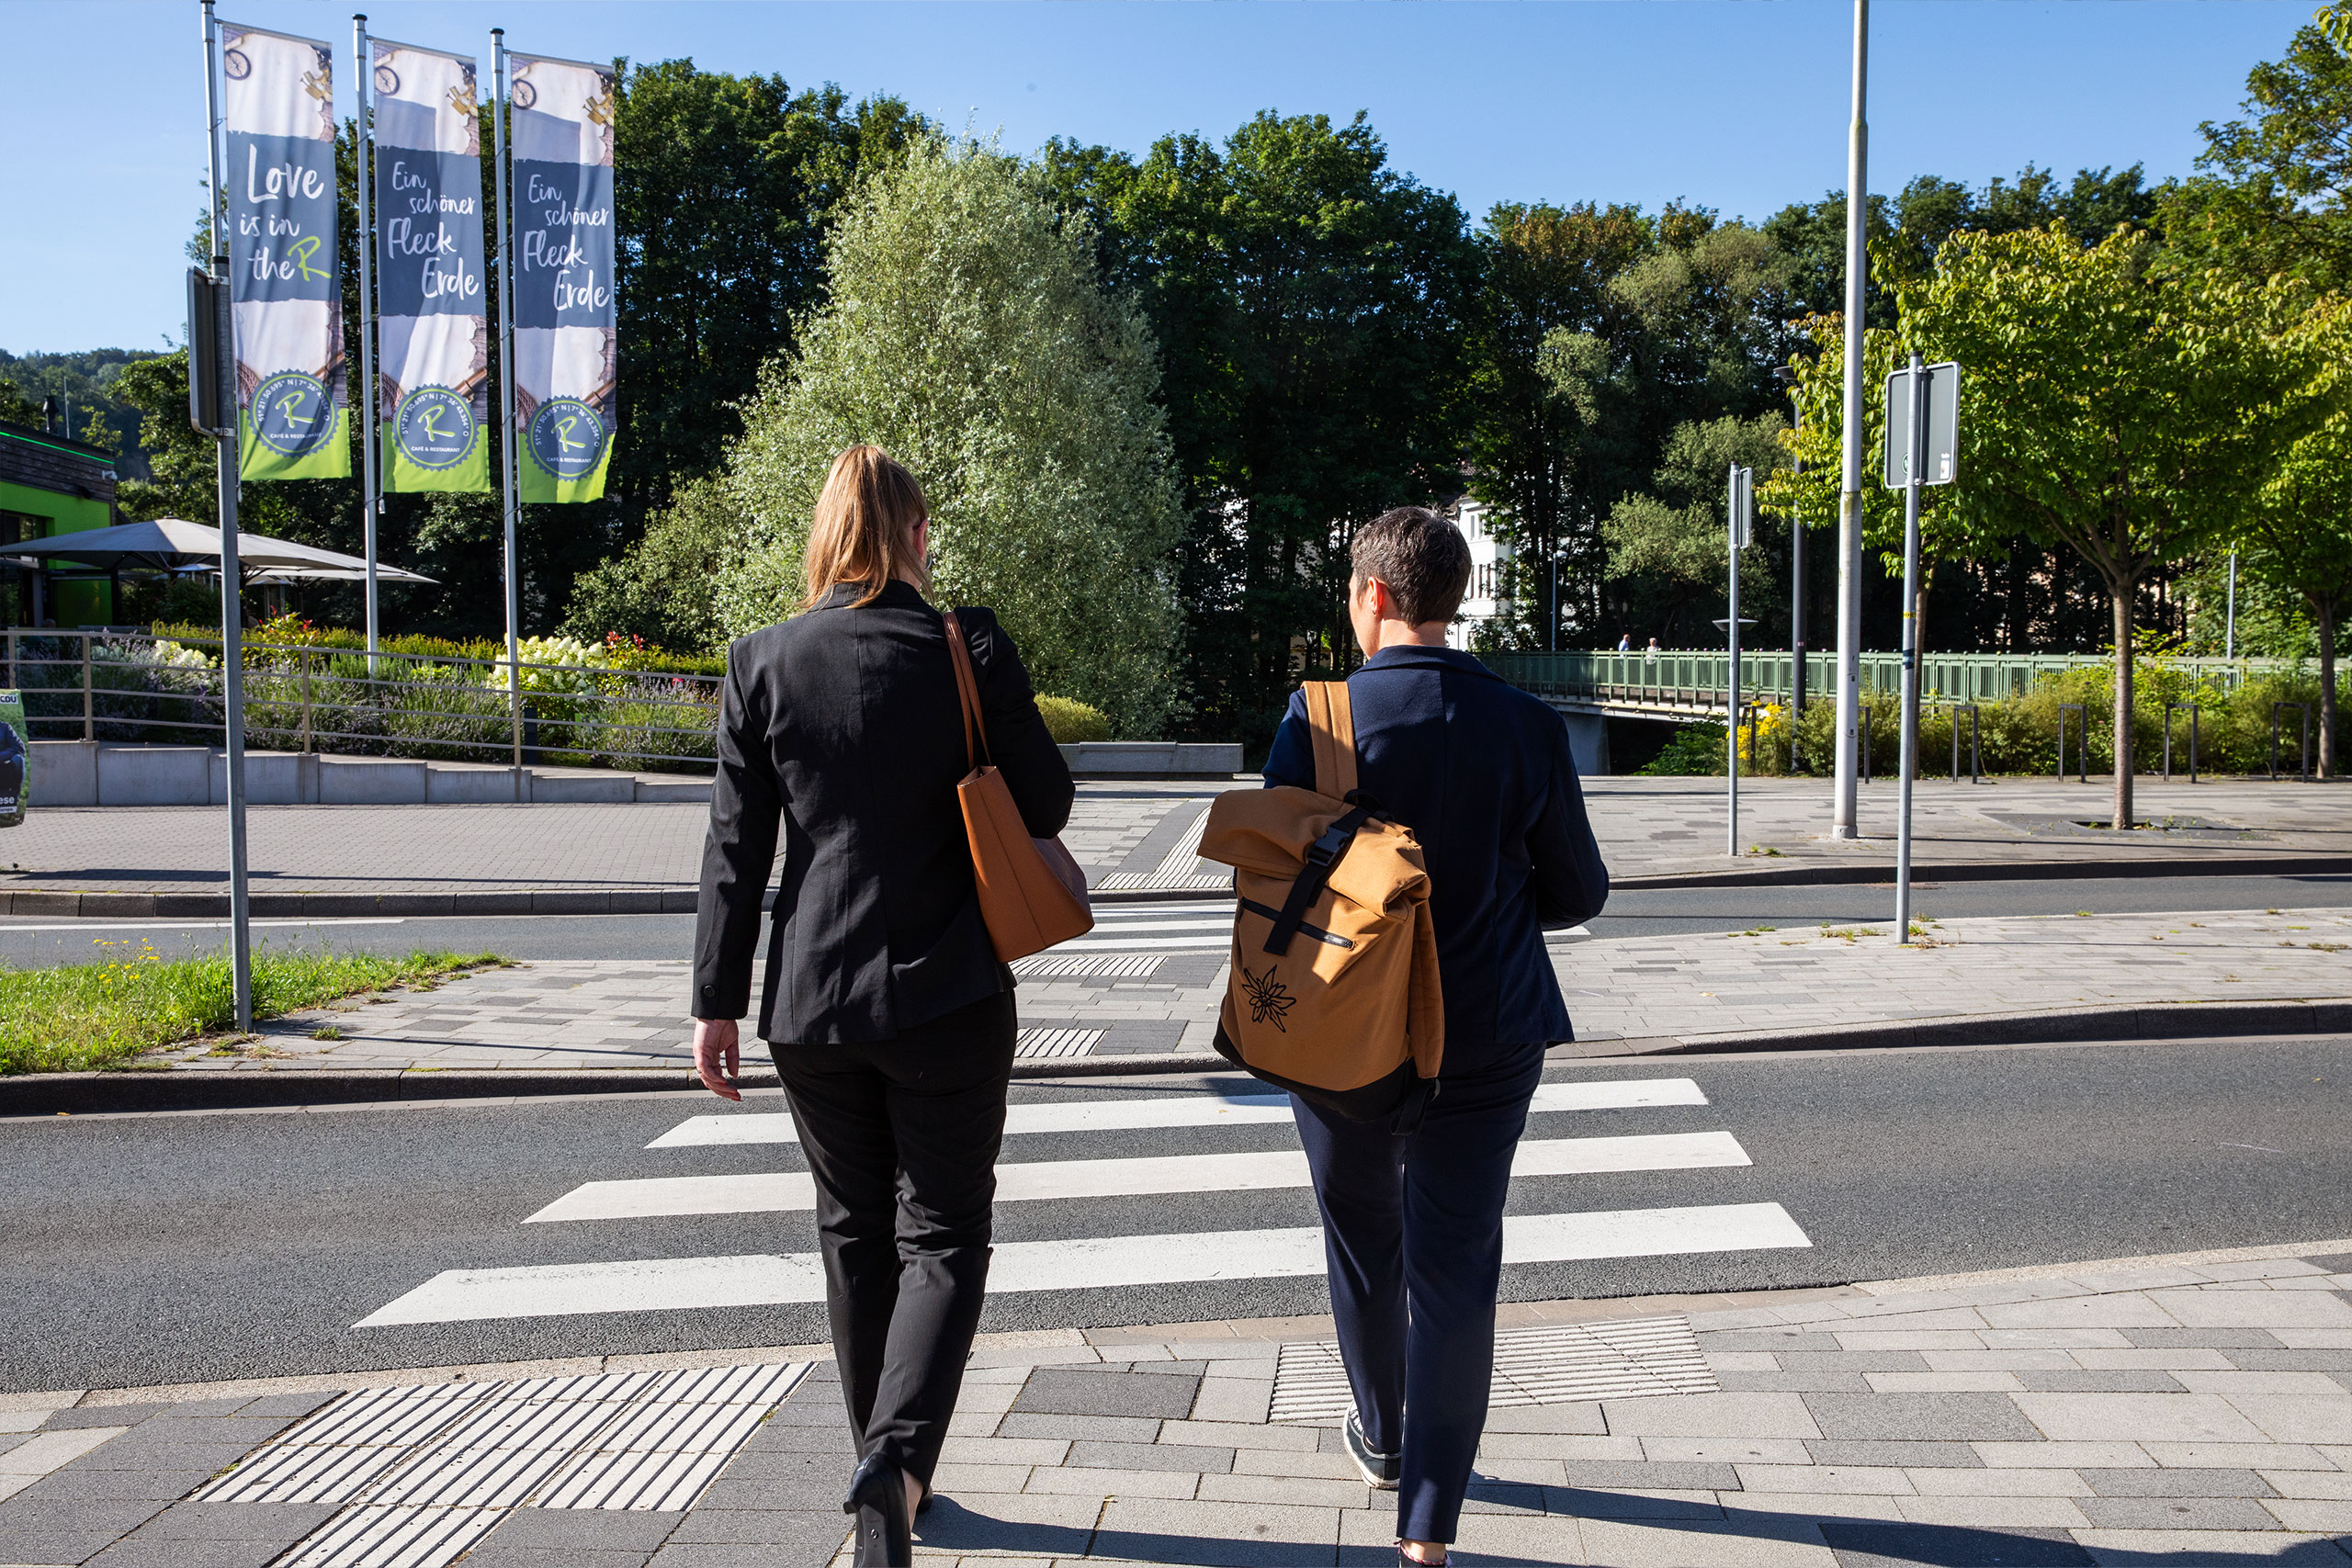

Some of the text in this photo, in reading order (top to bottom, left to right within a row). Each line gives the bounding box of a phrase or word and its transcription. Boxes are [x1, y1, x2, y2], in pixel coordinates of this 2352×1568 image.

[248, 143, 324, 203] Love
[392, 161, 426, 190] Ein
[528, 174, 562, 203] Ein
[409, 187, 476, 215] schöner
[545, 199, 610, 226] schöner
[240, 213, 300, 236] is in
[388, 217, 457, 259] Fleck
[246, 235, 332, 281] the R
[523, 229, 589, 272] Fleck
[421, 257, 480, 300] Erde
[553, 269, 610, 313] Erde
[275, 390, 316, 429] R
[417, 404, 456, 442] R
[551, 415, 586, 453] R
